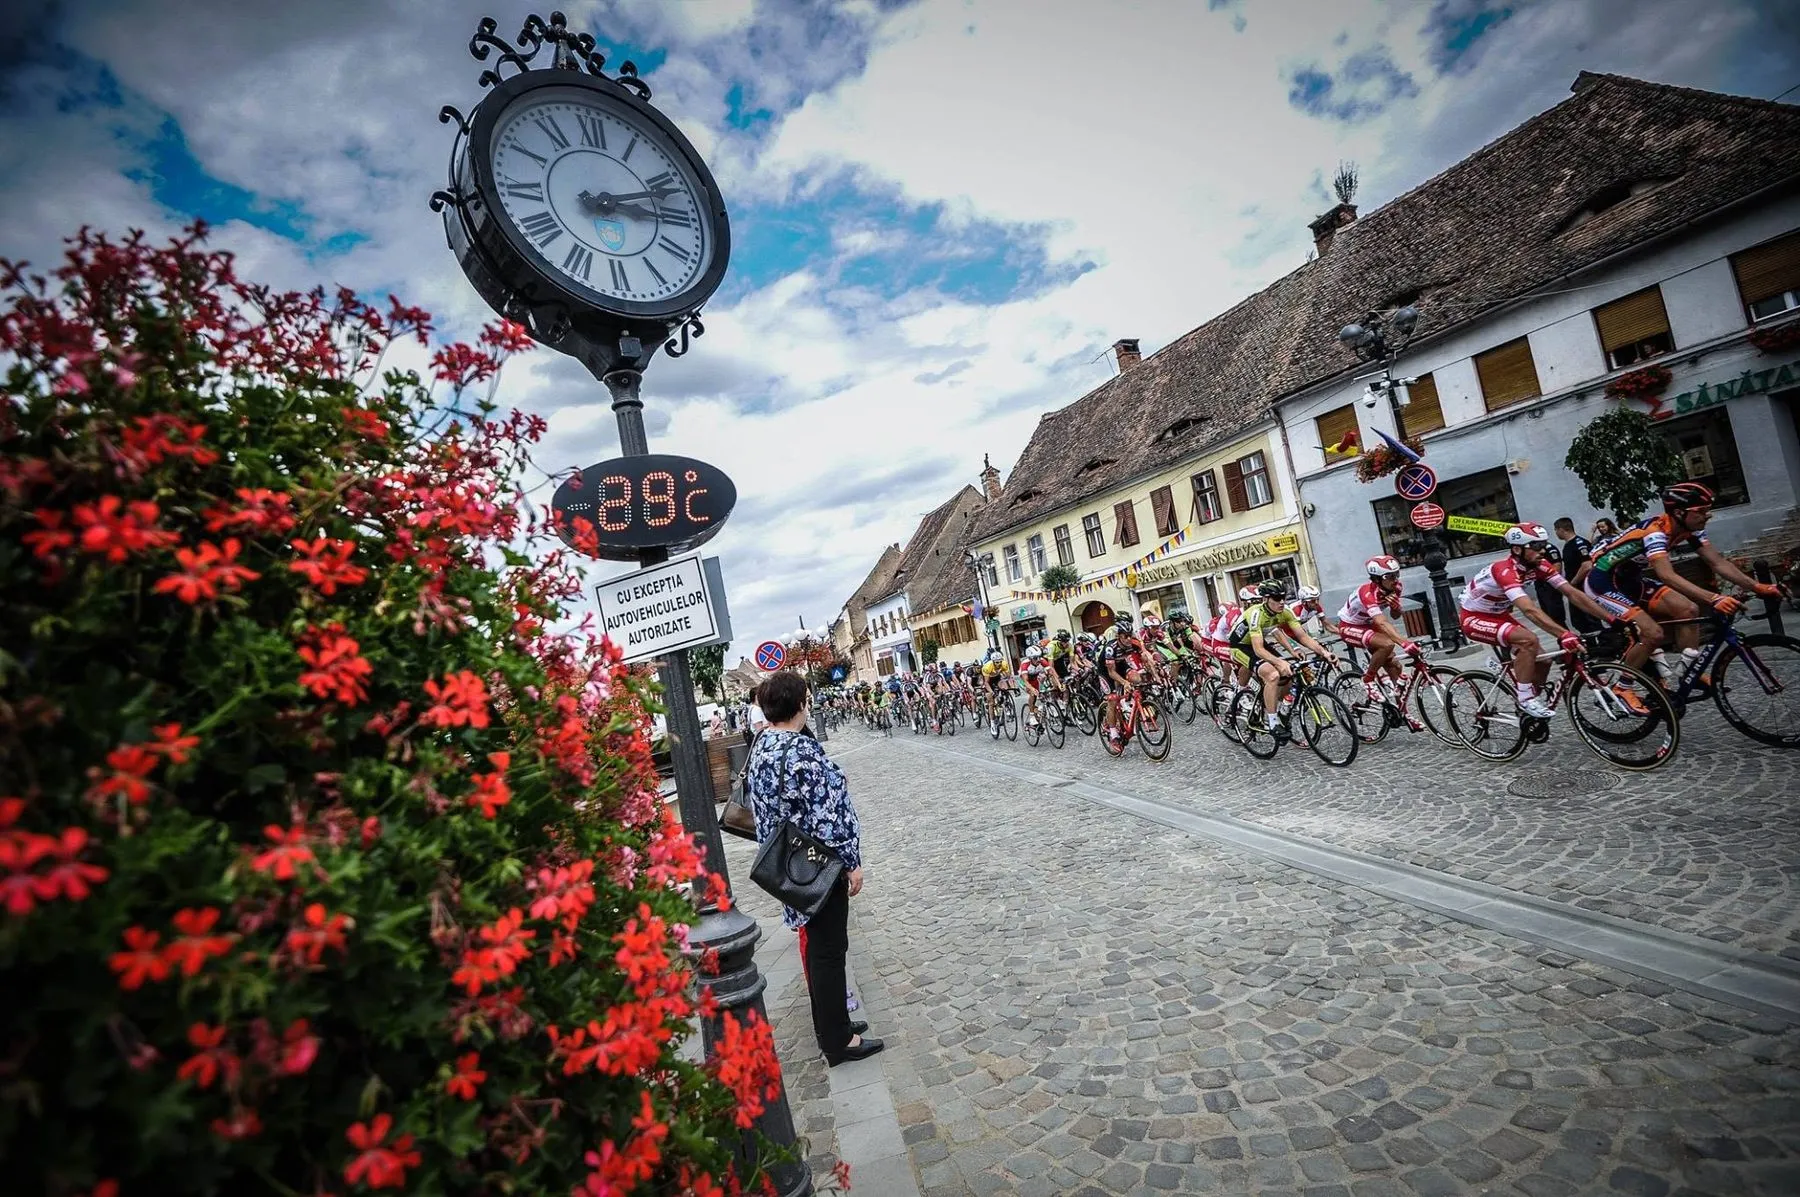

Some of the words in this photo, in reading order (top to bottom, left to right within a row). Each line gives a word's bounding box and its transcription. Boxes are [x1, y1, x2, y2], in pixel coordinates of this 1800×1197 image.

[1675, 359, 1800, 414] SĂNĂTA
[1453, 518, 1478, 526] OFERIM
[1511, 531, 1522, 541] 95
[1136, 564, 1178, 584] BANCA
[617, 591, 632, 605] CU
[607, 591, 705, 631] AUTOVEHICULELOR
[628, 616, 692, 646] AUTORIZATE
[1488, 660, 1499, 671] 95
